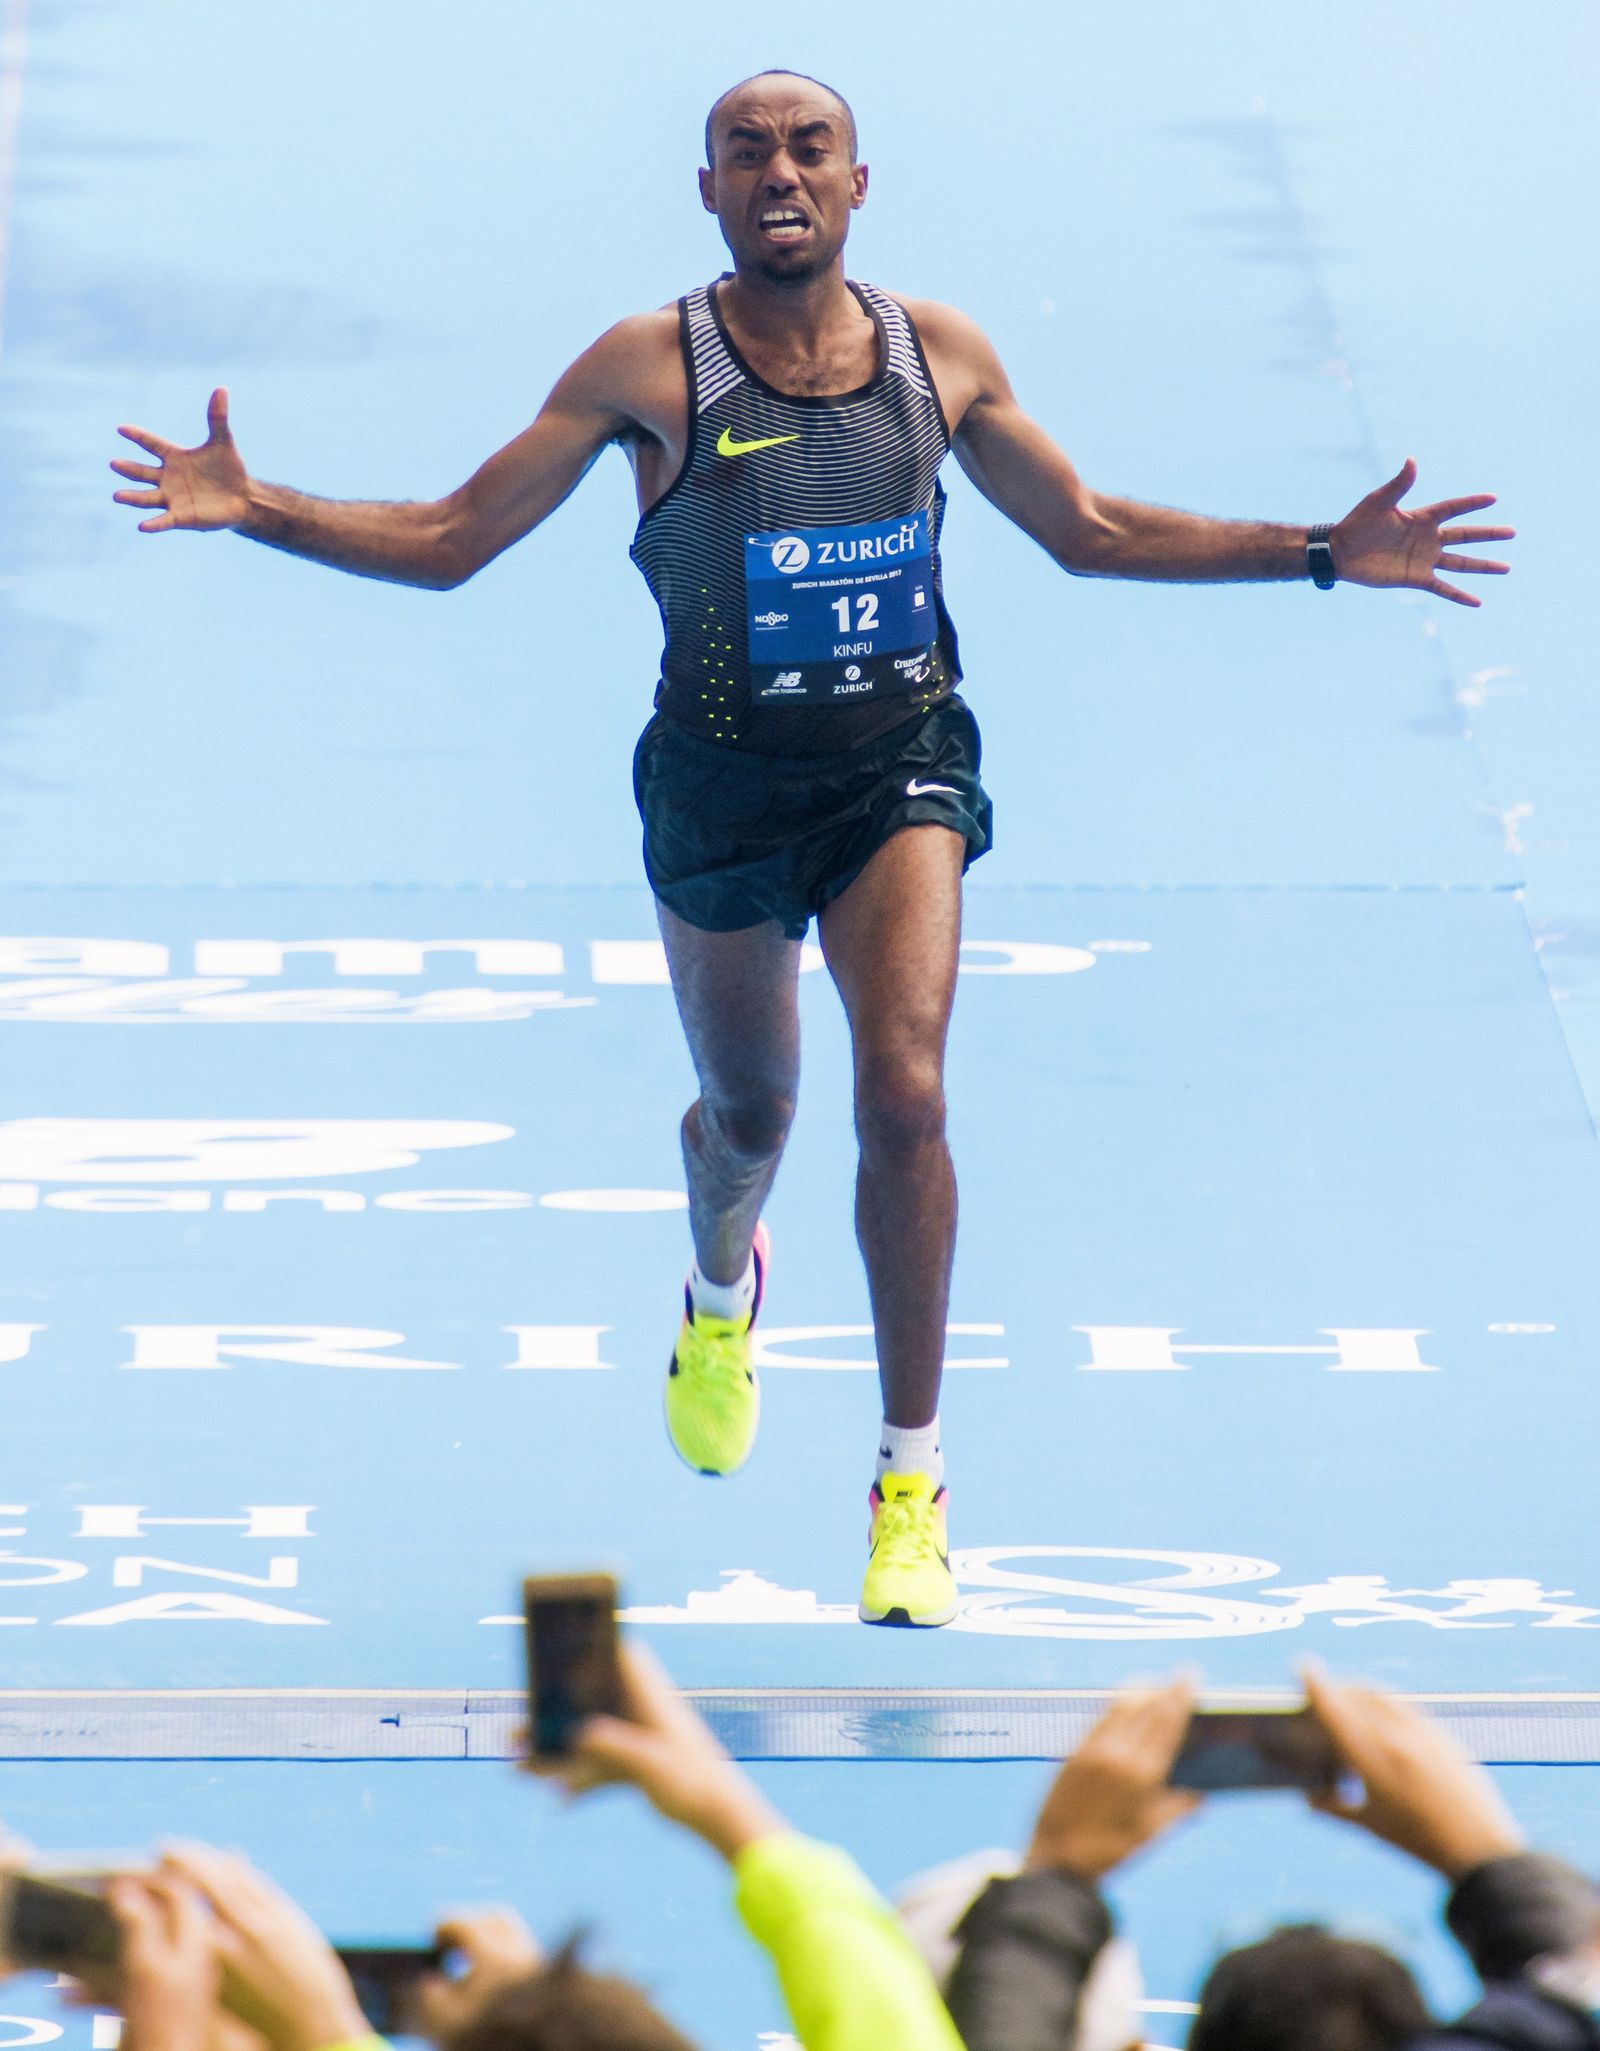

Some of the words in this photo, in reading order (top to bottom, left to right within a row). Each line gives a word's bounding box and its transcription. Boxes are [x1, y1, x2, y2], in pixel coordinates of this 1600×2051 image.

[817, 529, 915, 565] ZURICH
[792, 581, 818, 590] ZURICH
[819, 578, 854, 587] MARATÓN
[855, 577, 864, 585] DE
[865, 573, 888, 583] SEVILLA
[889, 569, 902, 578] 2017
[831, 593, 880, 633] 12
[833, 641, 873, 657] KINFU
[833, 681, 873, 694] ZURICH
[0, 1323, 1440, 1371] RICH
